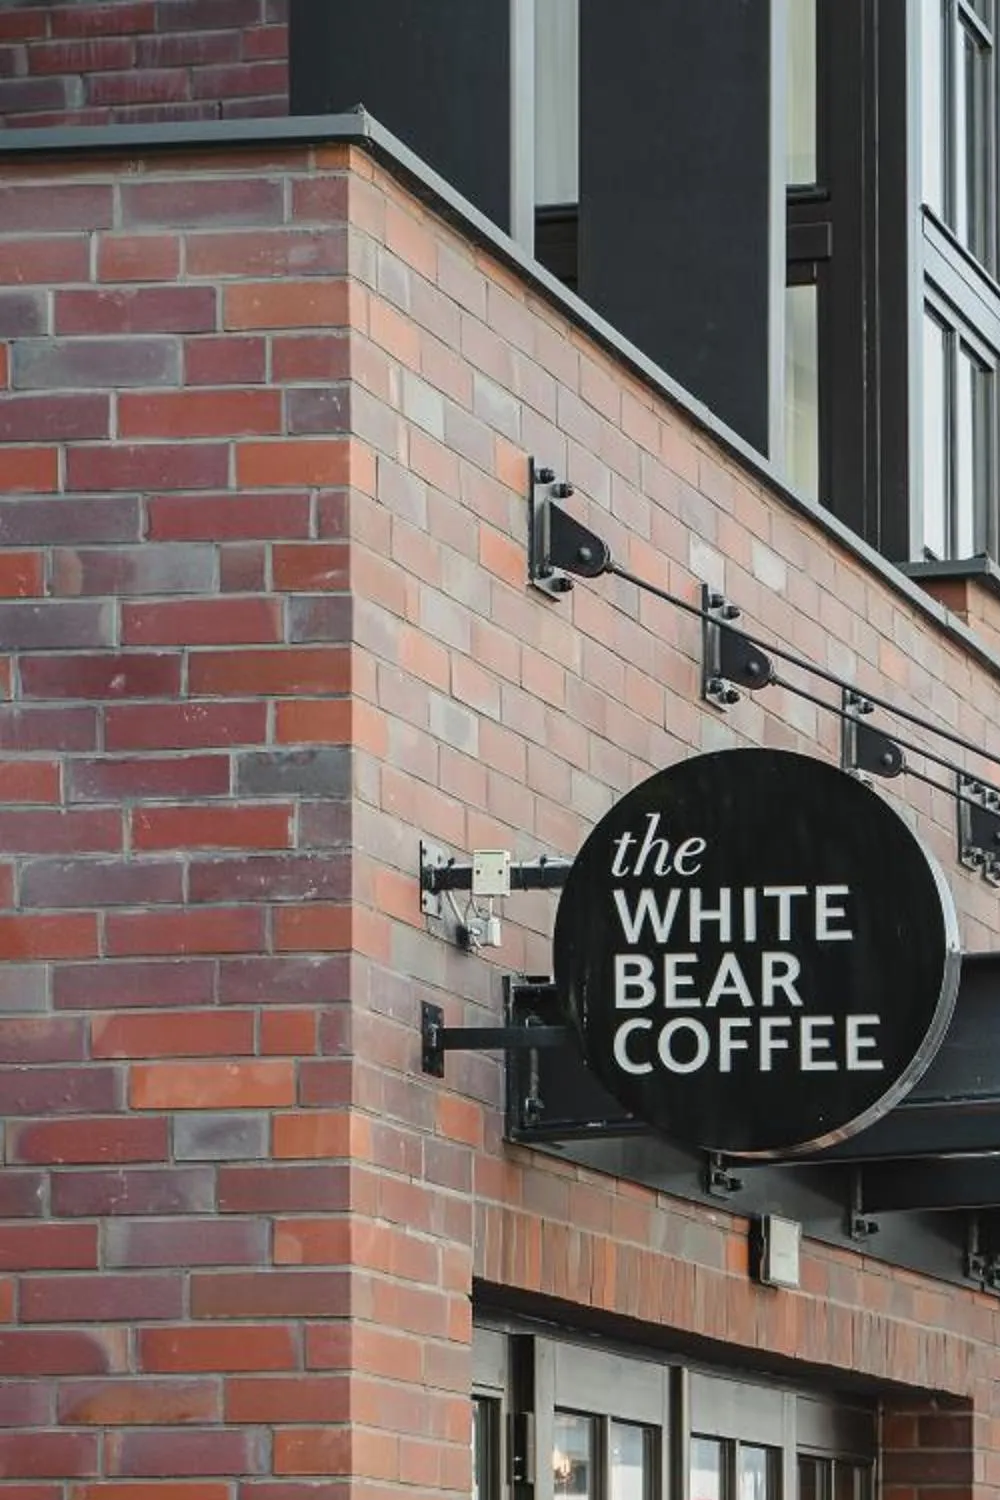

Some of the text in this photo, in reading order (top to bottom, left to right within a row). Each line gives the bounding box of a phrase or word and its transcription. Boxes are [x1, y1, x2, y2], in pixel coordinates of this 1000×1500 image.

[611, 813, 707, 877] the
[613, 884, 853, 944] WHITE
[614, 951, 803, 1009] BEAR
[613, 1014, 885, 1075] COFFEE
